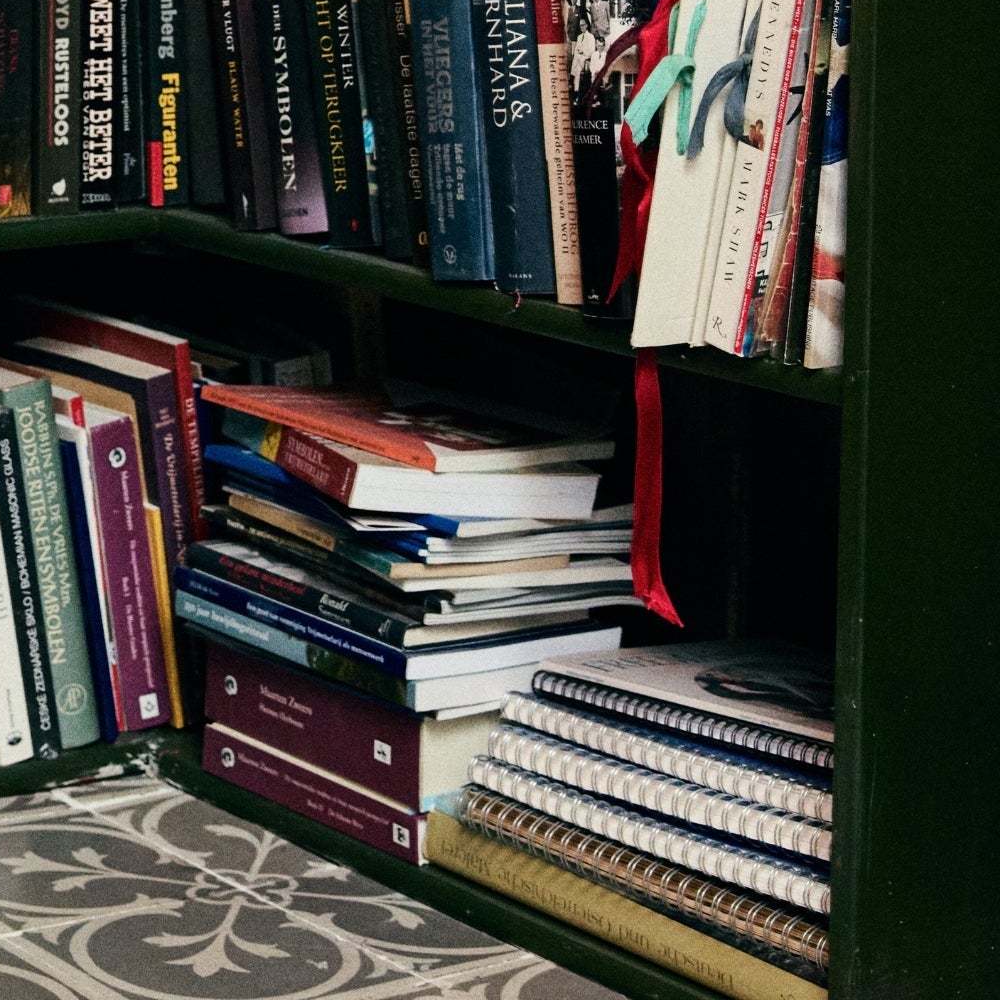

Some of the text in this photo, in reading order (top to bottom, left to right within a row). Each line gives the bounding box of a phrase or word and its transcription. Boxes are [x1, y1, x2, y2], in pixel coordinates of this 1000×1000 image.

[89, 57, 112, 101] HET
[319, 35, 335, 62] OP
[336, 4, 354, 89] WINTER
[53, 38, 70, 146] RUSTELOOS
[158, 72, 181, 190] Figuranten
[272, 36, 297, 192] SYMBOLEN
[322, 72, 348, 193] TERUGKEER
[400, 55, 423, 201] De laatste dagen
[510, 100, 531, 123] &
[552, 102, 562, 153] bewaarde
[89, 108, 112, 182] BETER
[0, 439, 21, 529] MASONIC GLASS
[18, 407, 66, 665] JOODSE RITEN SYMBOLEN
